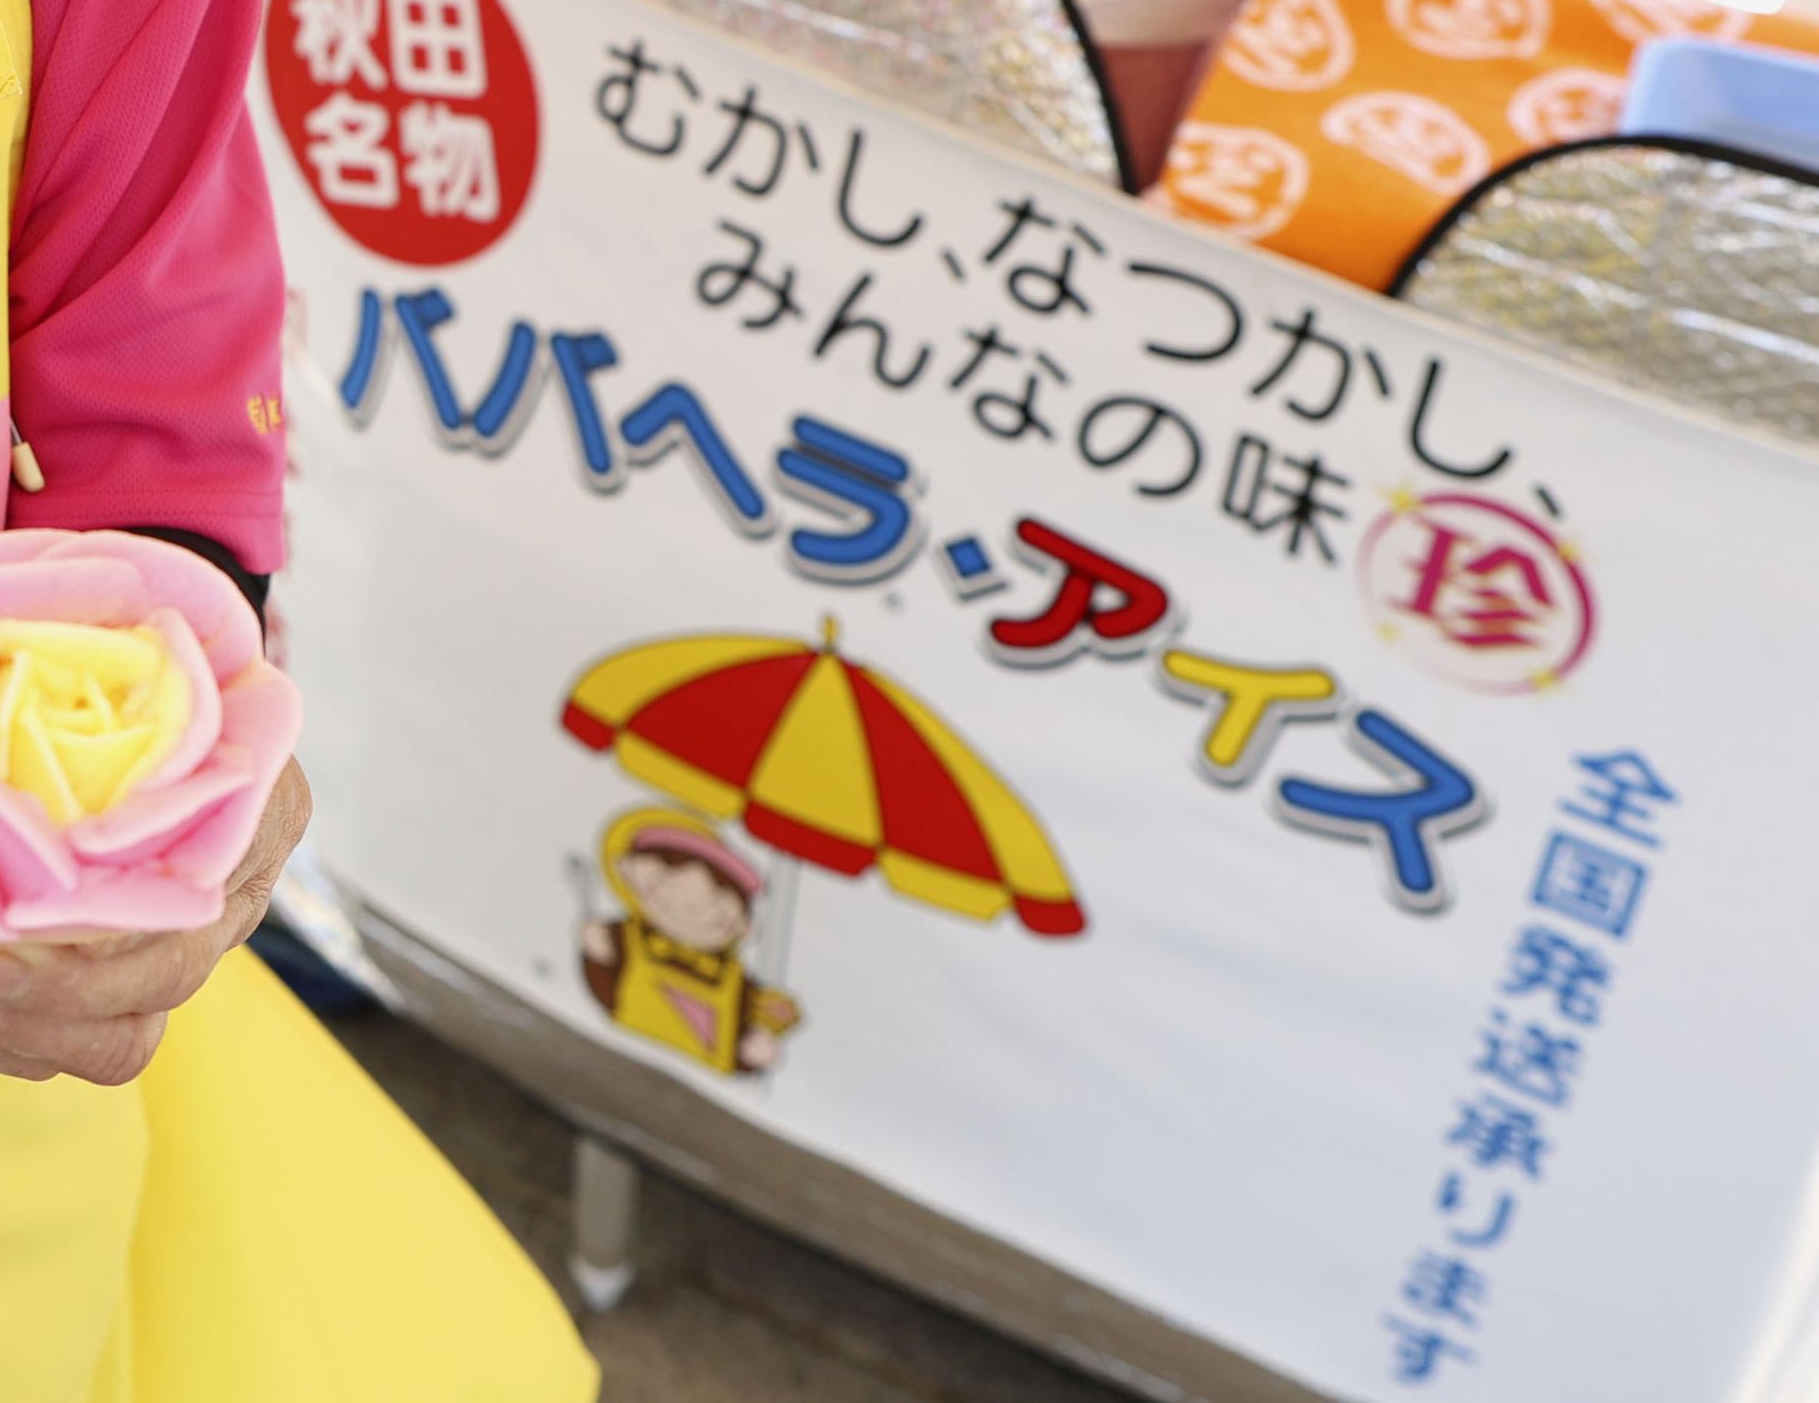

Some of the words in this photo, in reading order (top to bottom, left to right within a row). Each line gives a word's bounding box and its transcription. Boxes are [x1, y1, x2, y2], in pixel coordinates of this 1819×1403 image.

[305, 92, 501, 224] 名物
[595, 38, 1563, 518] むかし、なつかし、
[695, 220, 1355, 565] みんなの味
[1384, 517, 1554, 650] 珍
[1383, 749, 1680, 1386] 全国発送承ります
